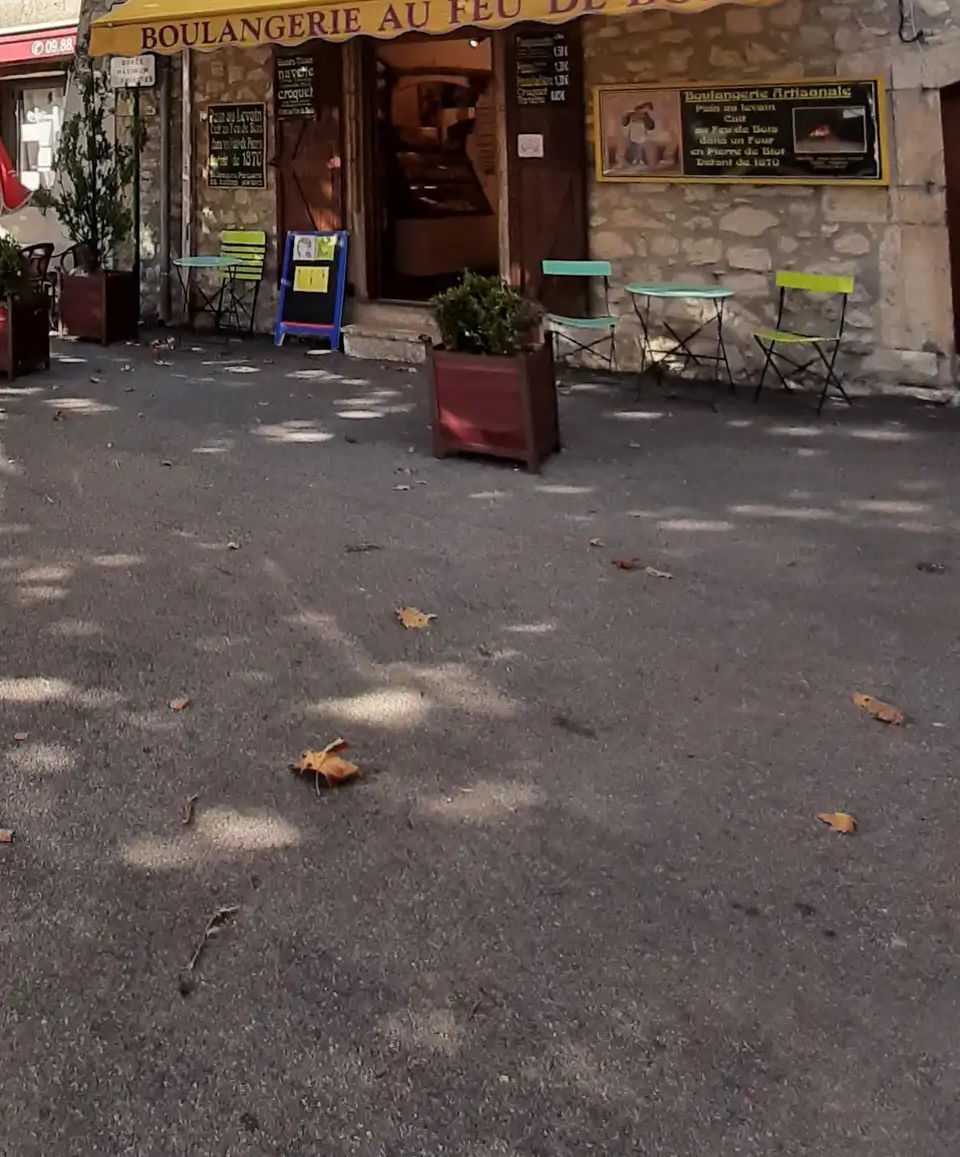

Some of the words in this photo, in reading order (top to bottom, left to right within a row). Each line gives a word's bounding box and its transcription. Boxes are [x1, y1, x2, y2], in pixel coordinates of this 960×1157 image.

[141, 8, 361, 49] BOULANGERIE
[378, 1, 430, 32] AU
[685, 89, 769, 102] Boulangerie
[773, 86, 853, 99] Artisanale
